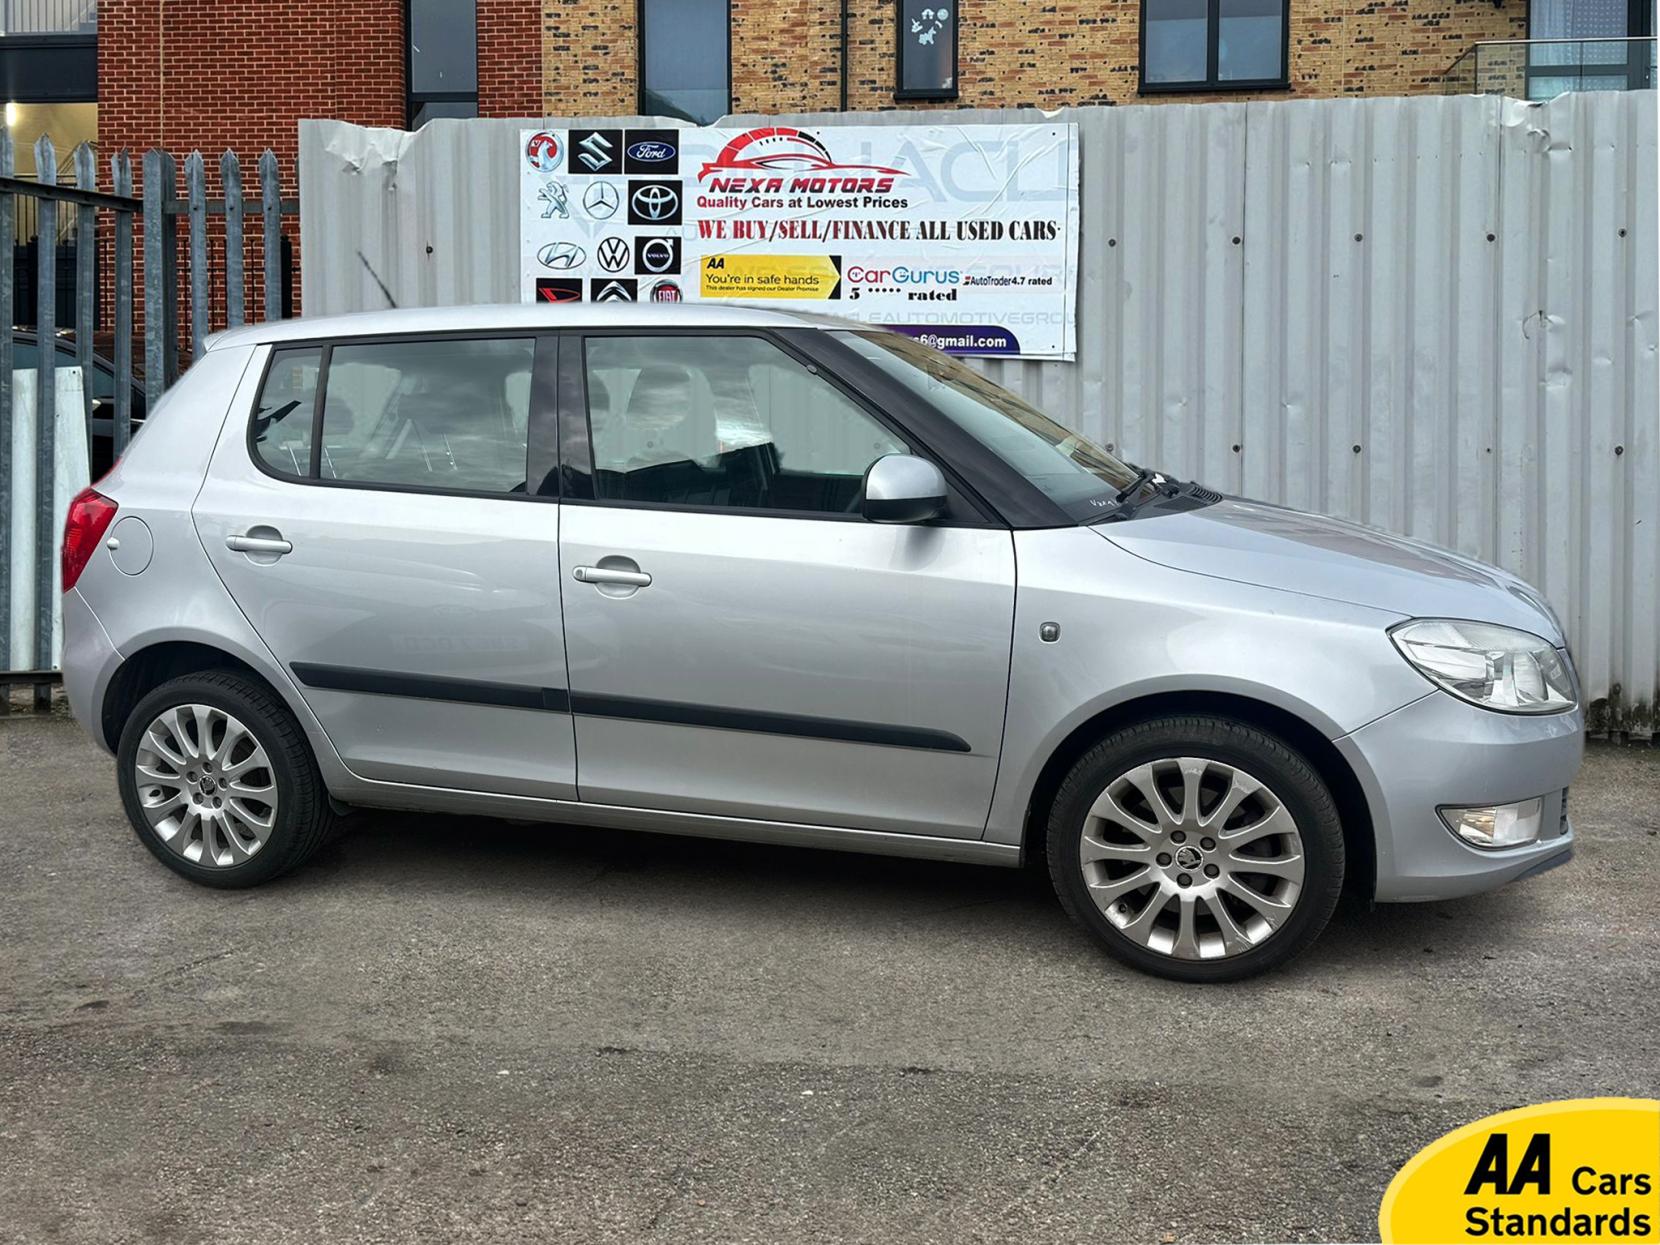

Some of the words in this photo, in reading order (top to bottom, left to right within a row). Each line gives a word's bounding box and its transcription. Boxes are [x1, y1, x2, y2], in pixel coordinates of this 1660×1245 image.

[636, 144, 666, 158] Ford
[709, 178, 783, 193] NEXA
[789, 178, 894, 193] MOTORS
[697, 196, 747, 210] Quality
[752, 196, 783, 208] Cars
[788, 197, 803, 208] at
[807, 196, 858, 208] Lowest
[863, 196, 908, 208] Prices
[698, 220, 726, 240] WE
[916, 220, 950, 240] ALL
[957, 220, 1004, 240] USED
[1009, 220, 1057, 240] CARS
[706, 257, 725, 269] AA
[706, 273, 741, 284] You're
[744, 273, 754, 284] in
[757, 274, 781, 284] safe
[784, 275, 819, 285] hands
[847, 266, 960, 284] CarGurus
[1028, 277, 1053, 285] rated
[658, 290, 676, 303] FIAT
[849, 287, 860, 300] 5
[908, 288, 957, 300] rated
